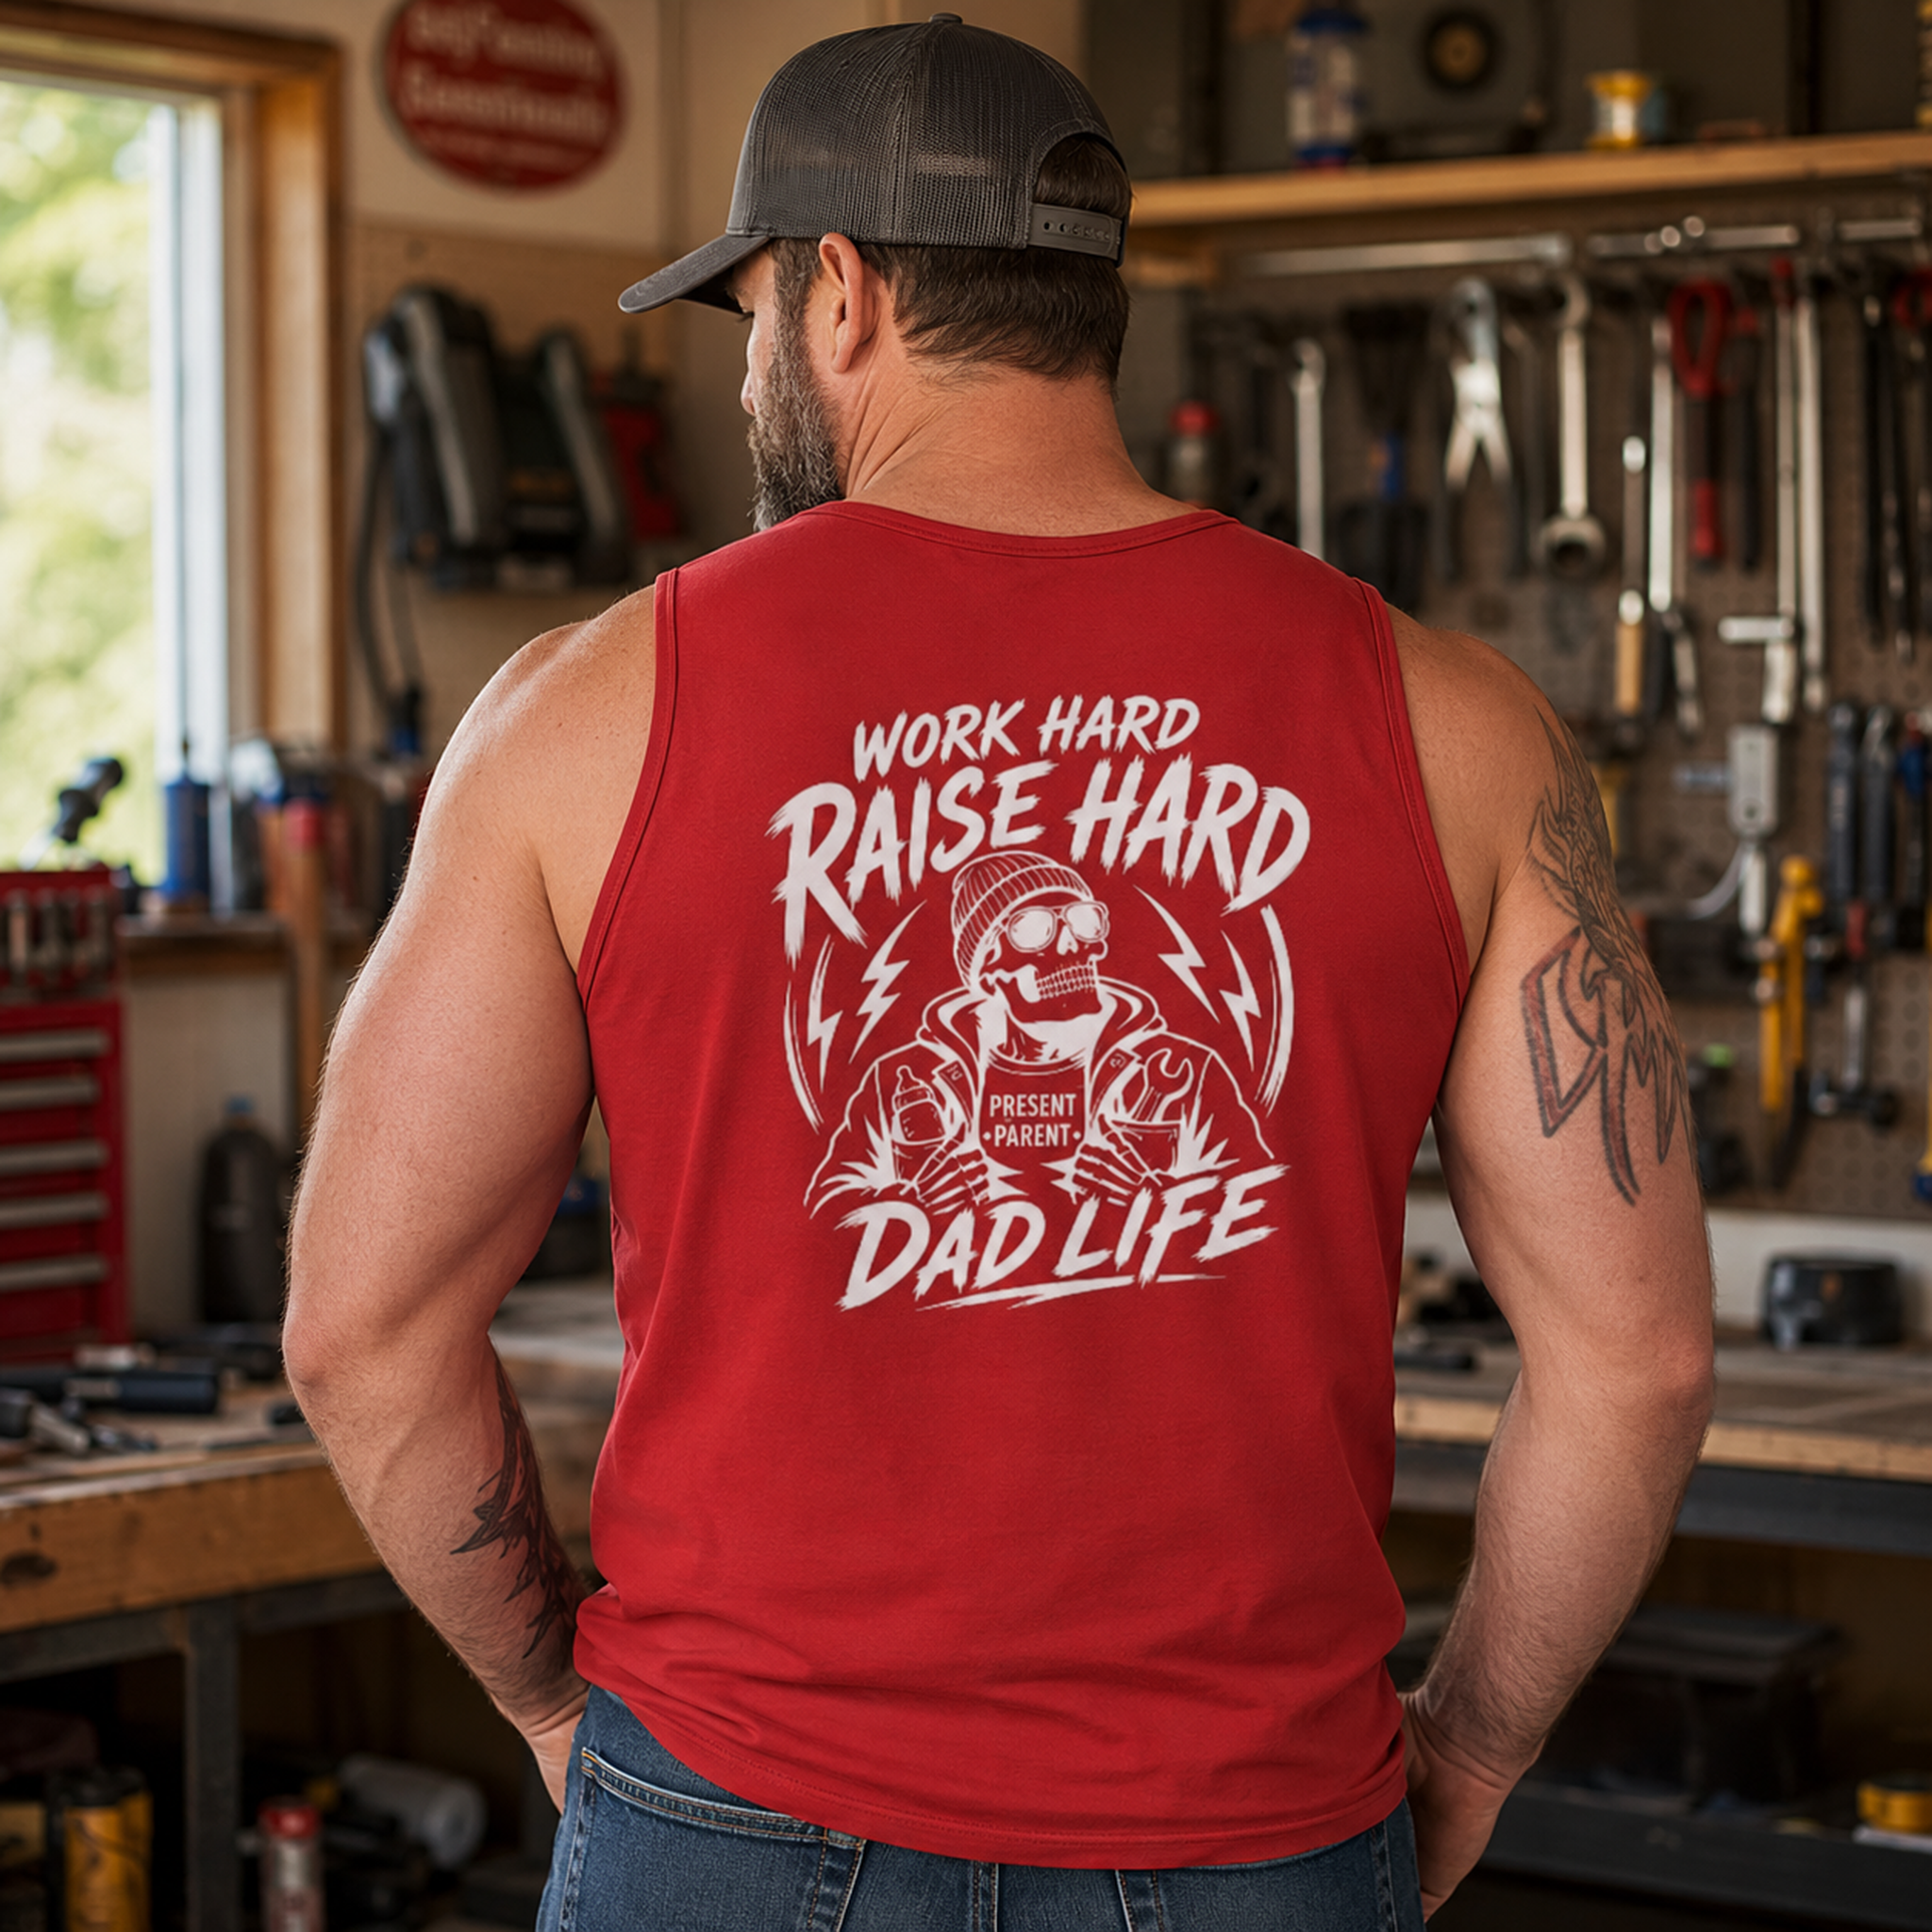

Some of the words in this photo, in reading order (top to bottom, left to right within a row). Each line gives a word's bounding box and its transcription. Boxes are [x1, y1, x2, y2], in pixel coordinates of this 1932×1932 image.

[853, 699, 1025, 782] WORK
[1038, 694, 1201, 755] HARD
[765, 759, 1058, 970] RAISE
[1064, 752, 1310, 916] HARD
[990, 1093, 1076, 1118] PRESENT
[834, 1200, 1046, 1312] DAD
[1052, 1164, 1291, 1289] LIFE
